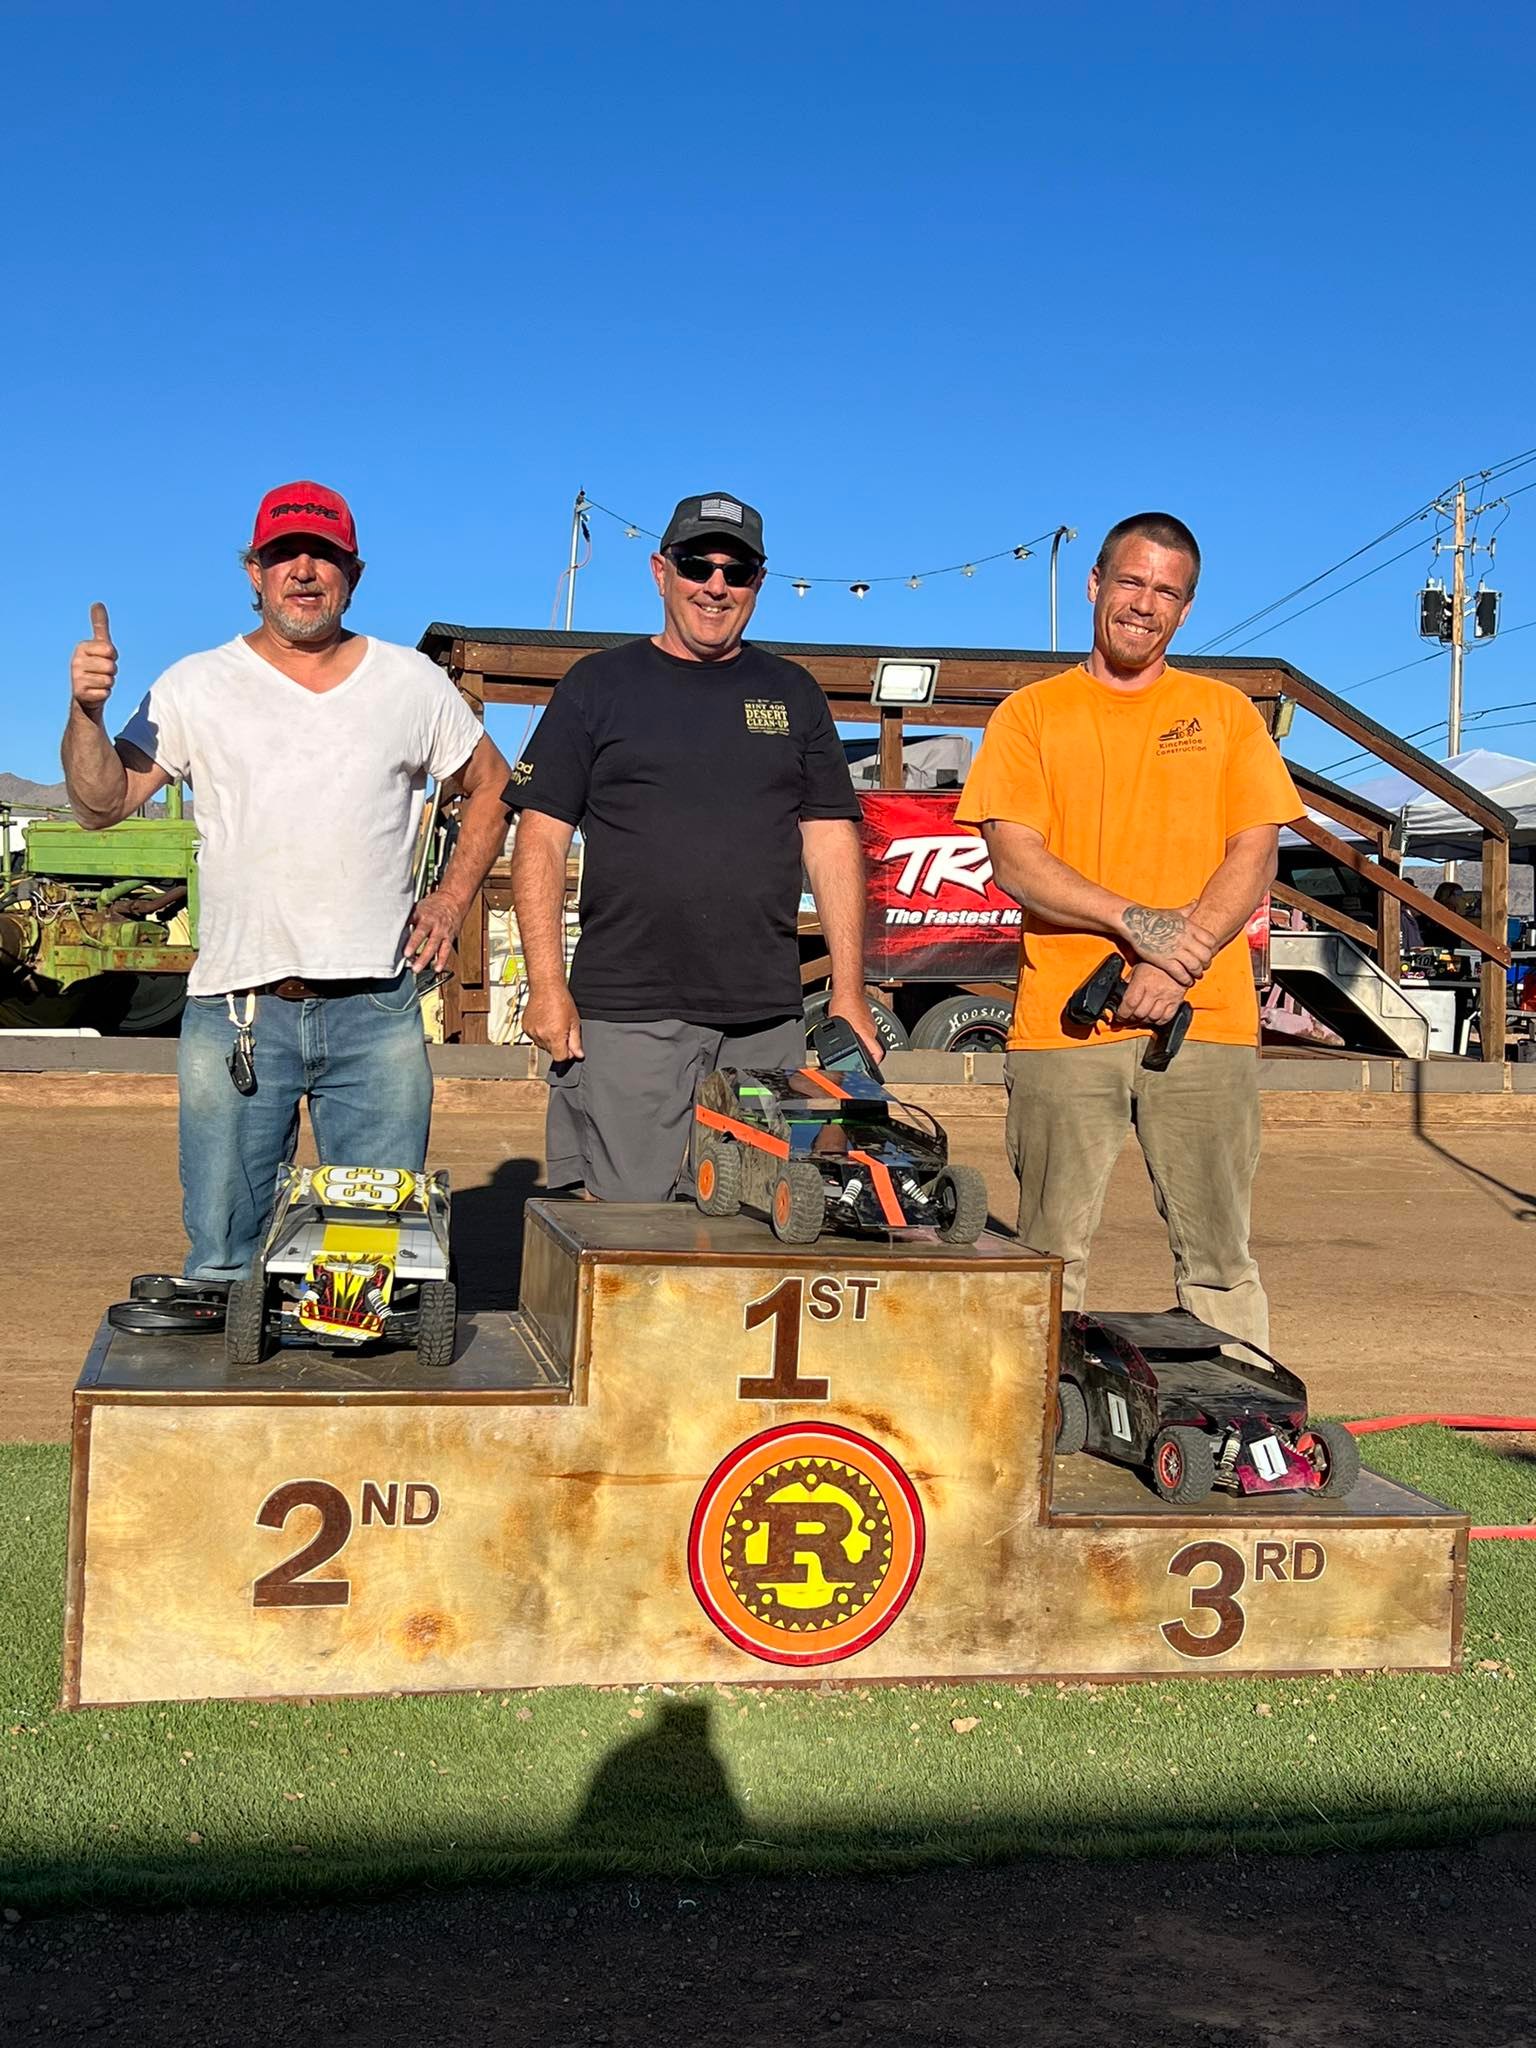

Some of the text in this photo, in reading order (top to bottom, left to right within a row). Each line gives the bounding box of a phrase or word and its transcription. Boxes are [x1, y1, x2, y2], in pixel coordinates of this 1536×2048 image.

[745, 709, 788, 720] DESERT
[746, 718, 789, 728] CLEAN-UP
[1156, 746, 1207, 756] Construction
[886, 909, 923, 924] The
[923, 909, 1000, 925] Fastest
[736, 1276, 880, 1402] 1ST
[252, 1477, 442, 1609] 2ND
[1159, 1540, 1327, 1660] 3RD
